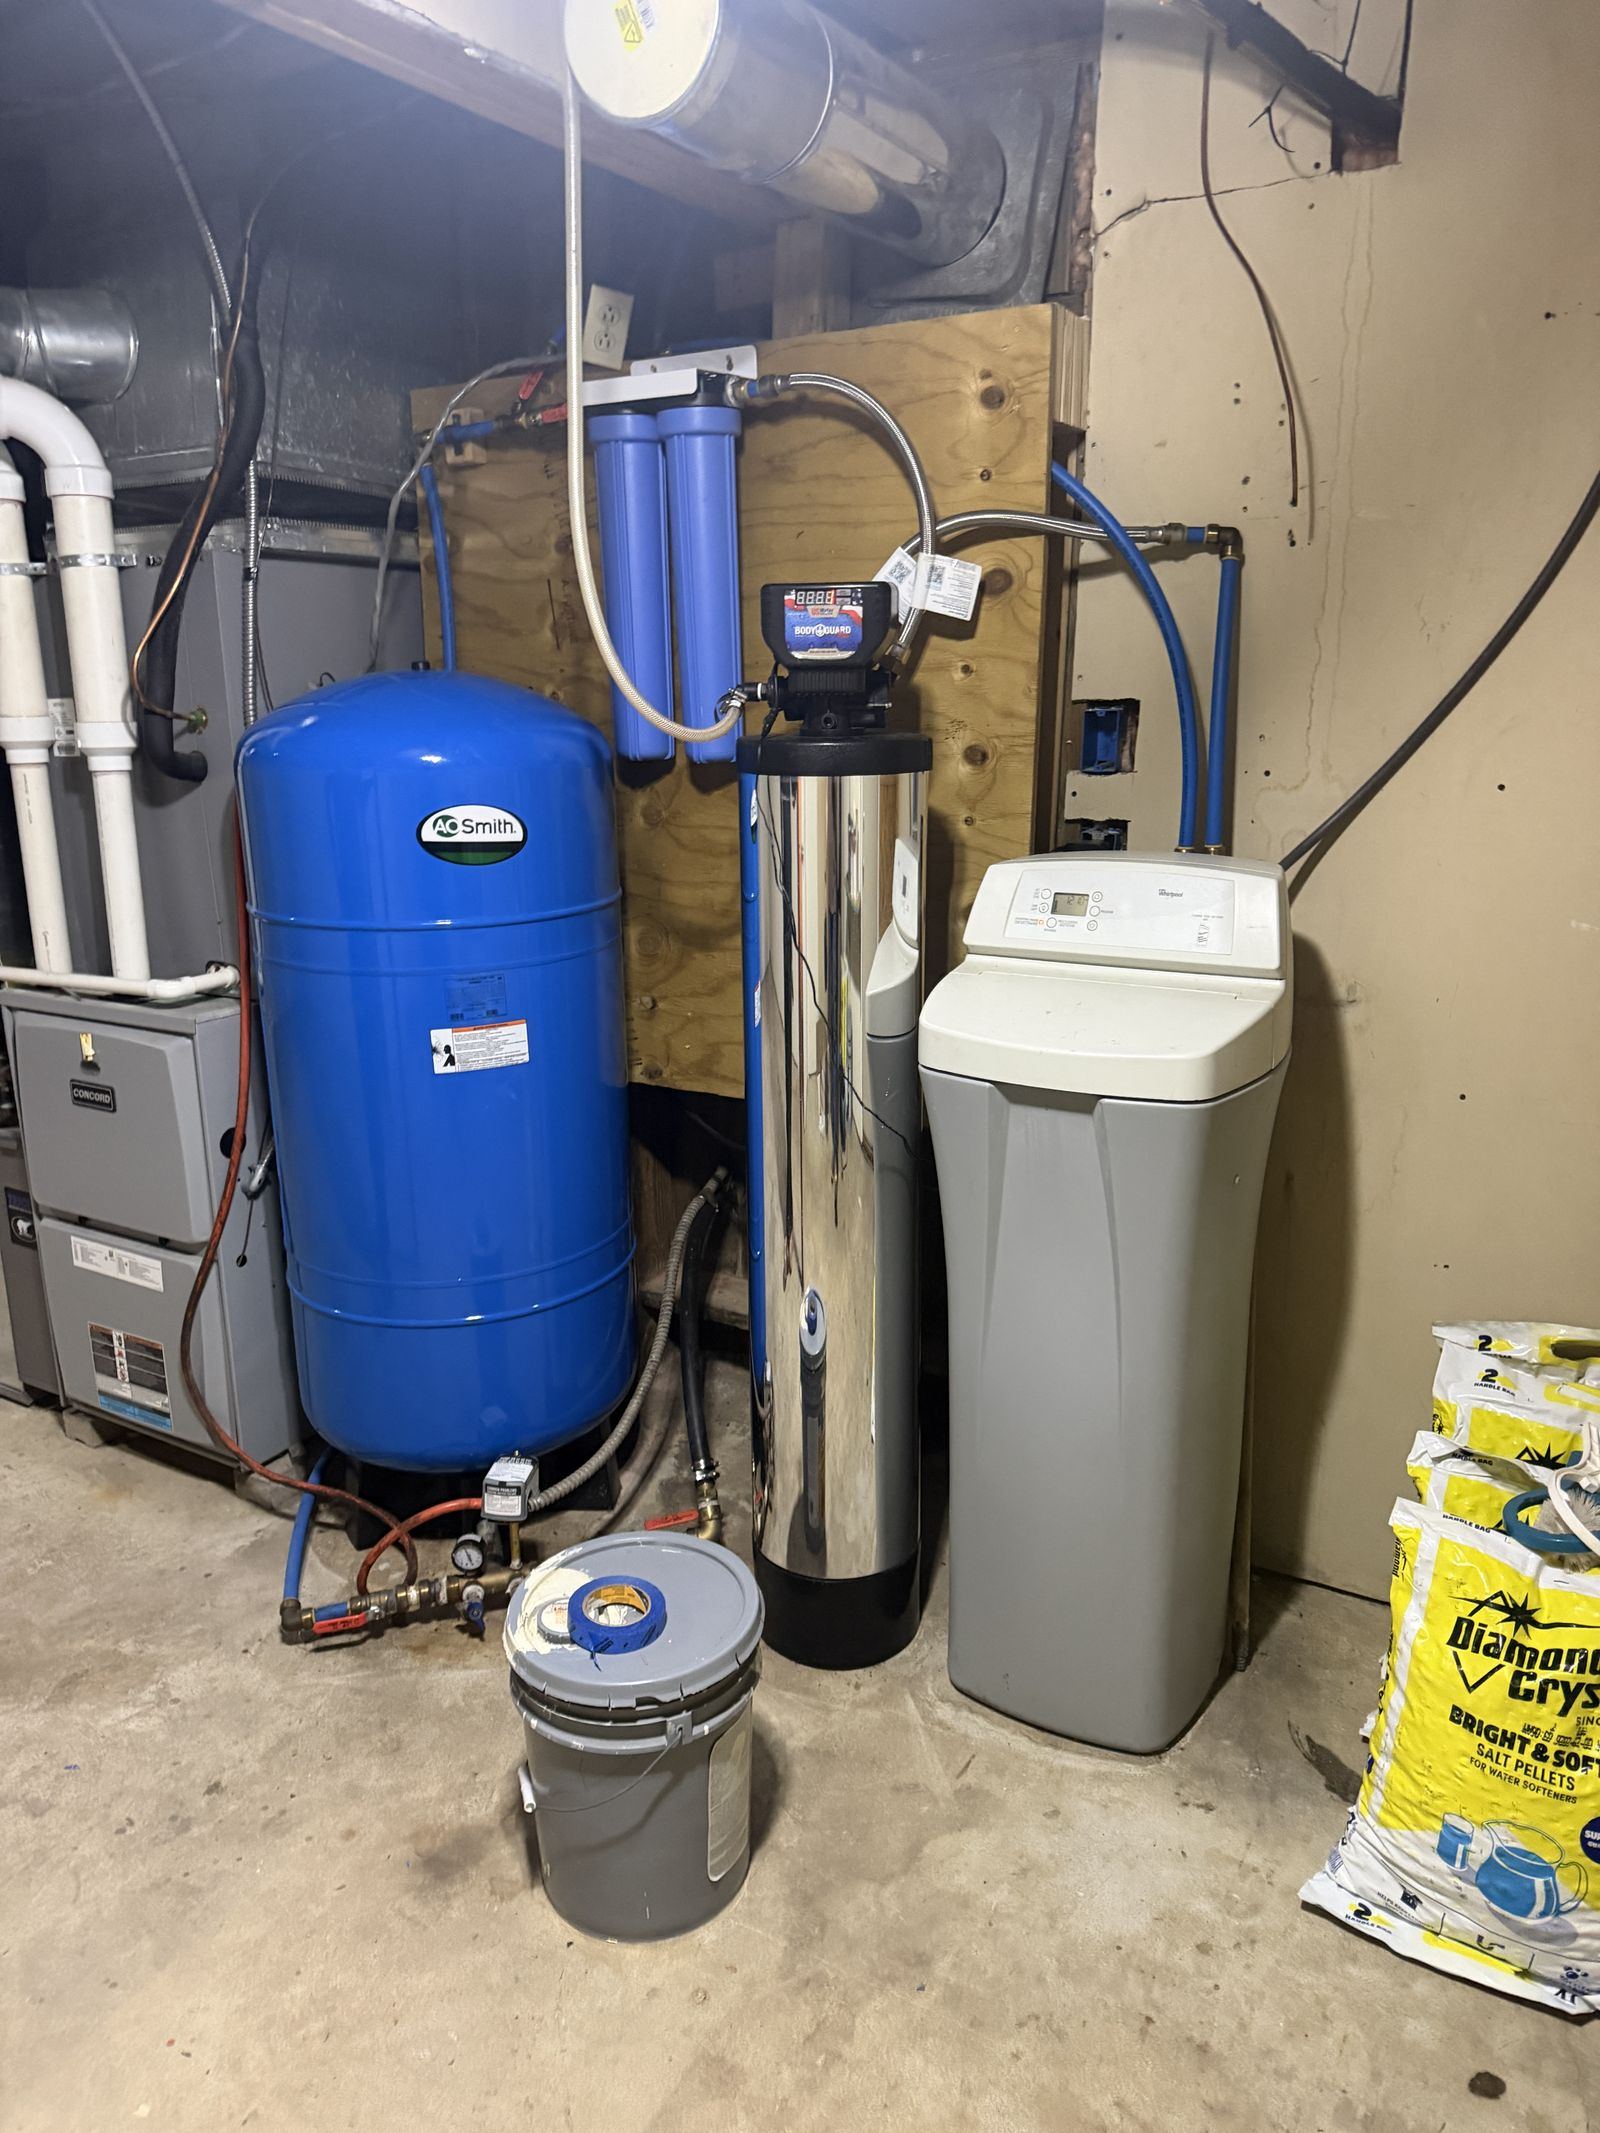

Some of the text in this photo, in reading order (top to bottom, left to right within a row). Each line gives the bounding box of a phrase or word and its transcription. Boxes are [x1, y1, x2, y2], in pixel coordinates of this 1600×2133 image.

[795, 626, 851, 635] BODY GUARD
[433, 817, 514, 836] AO Smith
[73, 1088, 111, 1104] CONCORD
[1478, 1335, 1493, 1352] 2
[1481, 1368, 1499, 1383] 2
[1474, 1382, 1501, 1391] HANDLE
[1442, 1513, 1491, 1534] HANDLE BAG
[1449, 1704, 1531, 1755] BRIGHT
[1531, 1743, 1550, 1763] &
[1476, 1743, 1576, 1791] SALT PELLETS
[1470, 1757, 1577, 1805] FOR WATER SOFTENERS
[1353, 1902, 1373, 1921] 2
